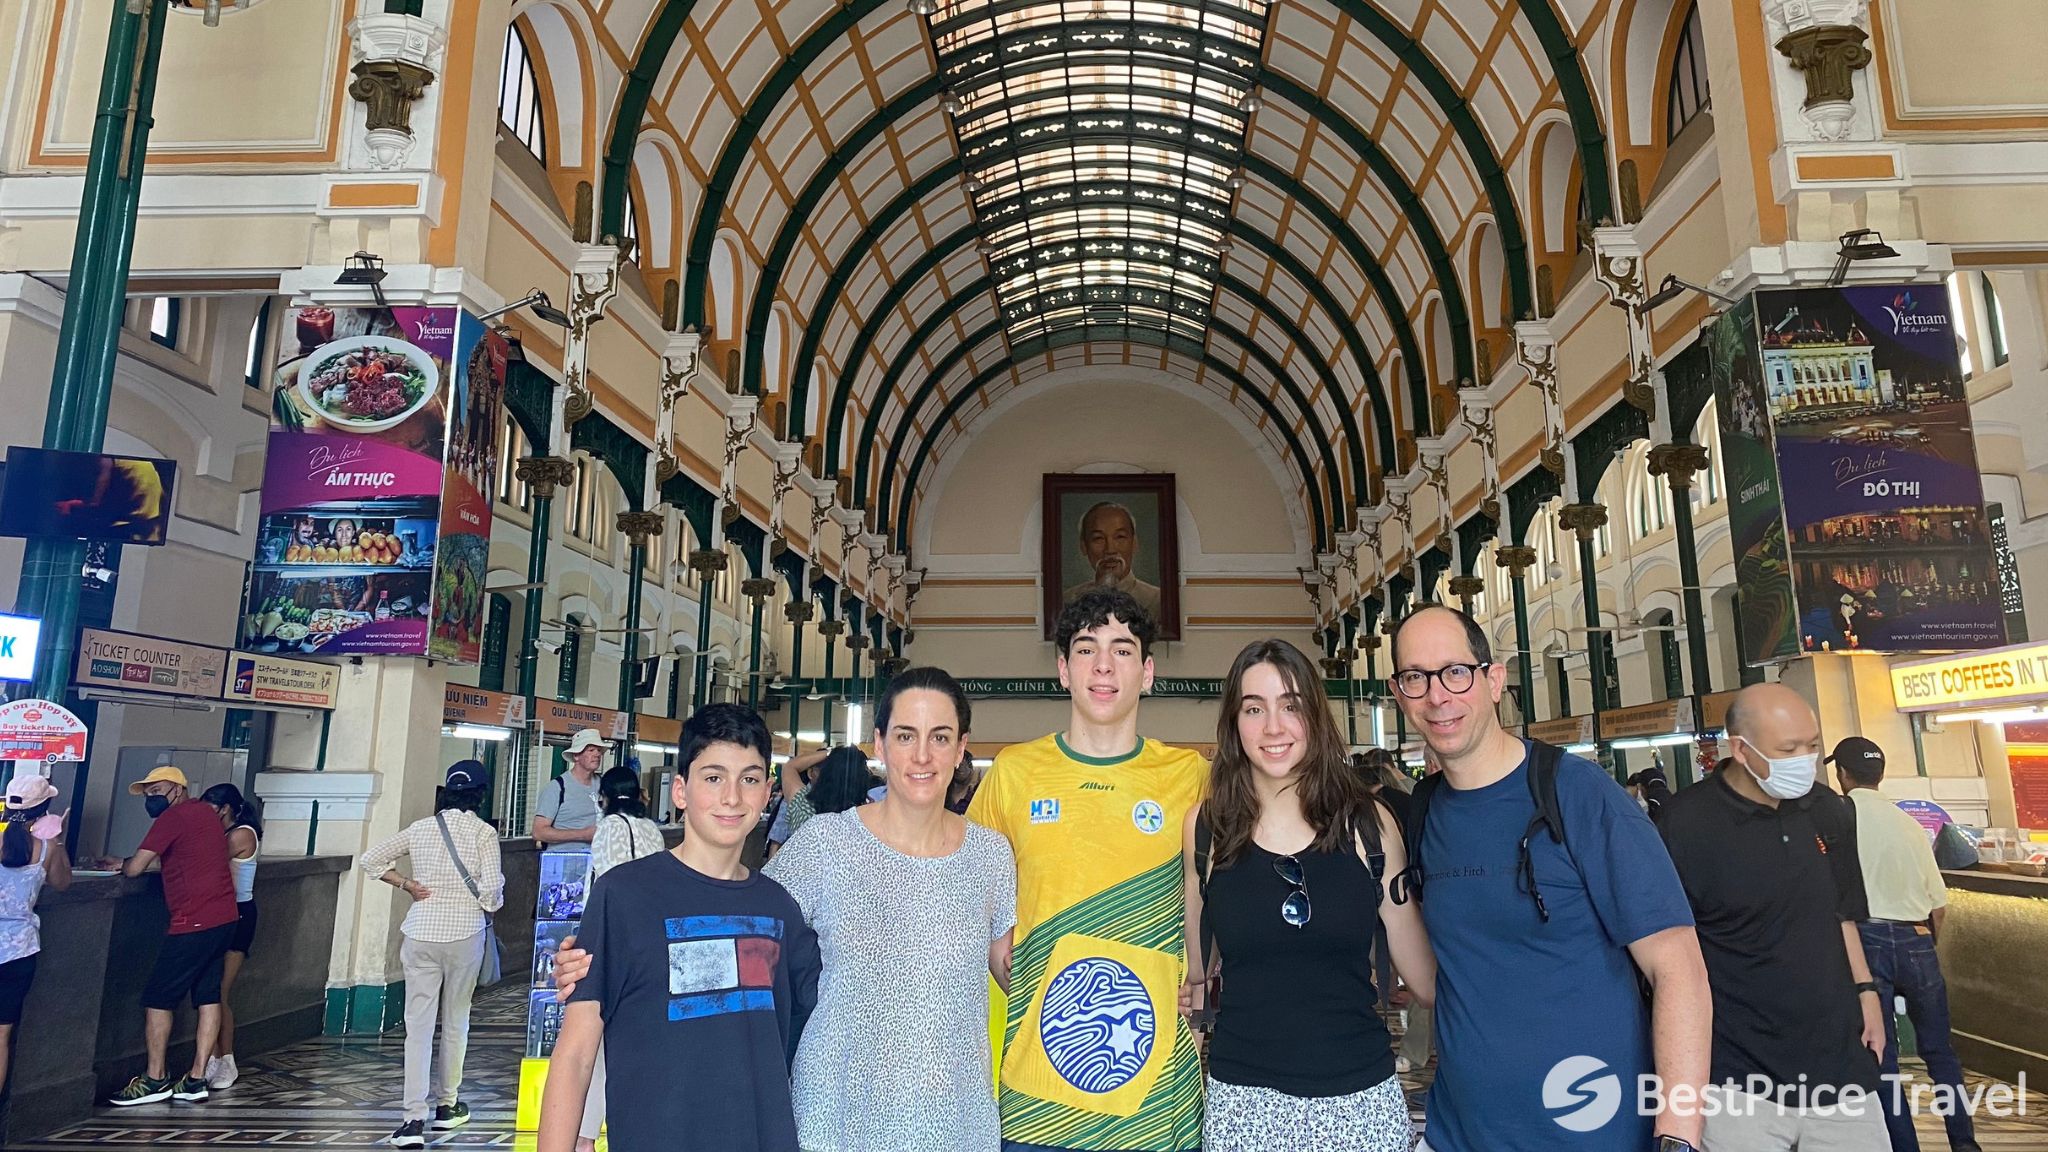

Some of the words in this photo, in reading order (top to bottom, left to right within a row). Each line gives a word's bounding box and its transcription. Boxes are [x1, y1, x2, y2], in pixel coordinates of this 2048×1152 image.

[415, 320, 453, 340] Vietnam
[1881, 305, 1948, 336] Vietnam
[309, 446, 335, 470] Du
[338, 441, 364, 463] lịch
[1831, 456, 1859, 480] Du
[1863, 451, 1888, 473] lịch
[325, 467, 352, 486] ẨM
[352, 472, 396, 489] THỰC
[1863, 478, 1889, 497] ĐÔ
[1891, 481, 1920, 499] THỊ
[1920, 620, 1997, 629] www.vietnam.travel
[0, 635, 17, 658] K
[1891, 632, 1999, 642] www.vietnamtourism.gov.vn
[93, 642, 130, 660] TICKET
[133, 648, 181, 667] COUNTER
[1006, 680, 1045, 692] CHÍNH
[1169, 680, 1200, 692] TOÀN
[1902, 672, 1937, 698] BEST
[1941, 660, 2015, 695] COFFEES
[2016, 658, 2036, 685] IN
[463, 692, 488, 709] NIỆM
[38, 702, 61, 715] Hop
[62, 714, 78, 728] off
[569, 708, 583, 720] LƯU
[584, 711, 602, 724] NIỆM
[2, 723, 18, 731] Buy
[21, 723, 45, 731] ticket
[47, 723, 65, 731] here
[1030, 799, 1060, 816] M21
[1452, 868, 1461, 878] &
[1463, 865, 1486, 878] Fitch
